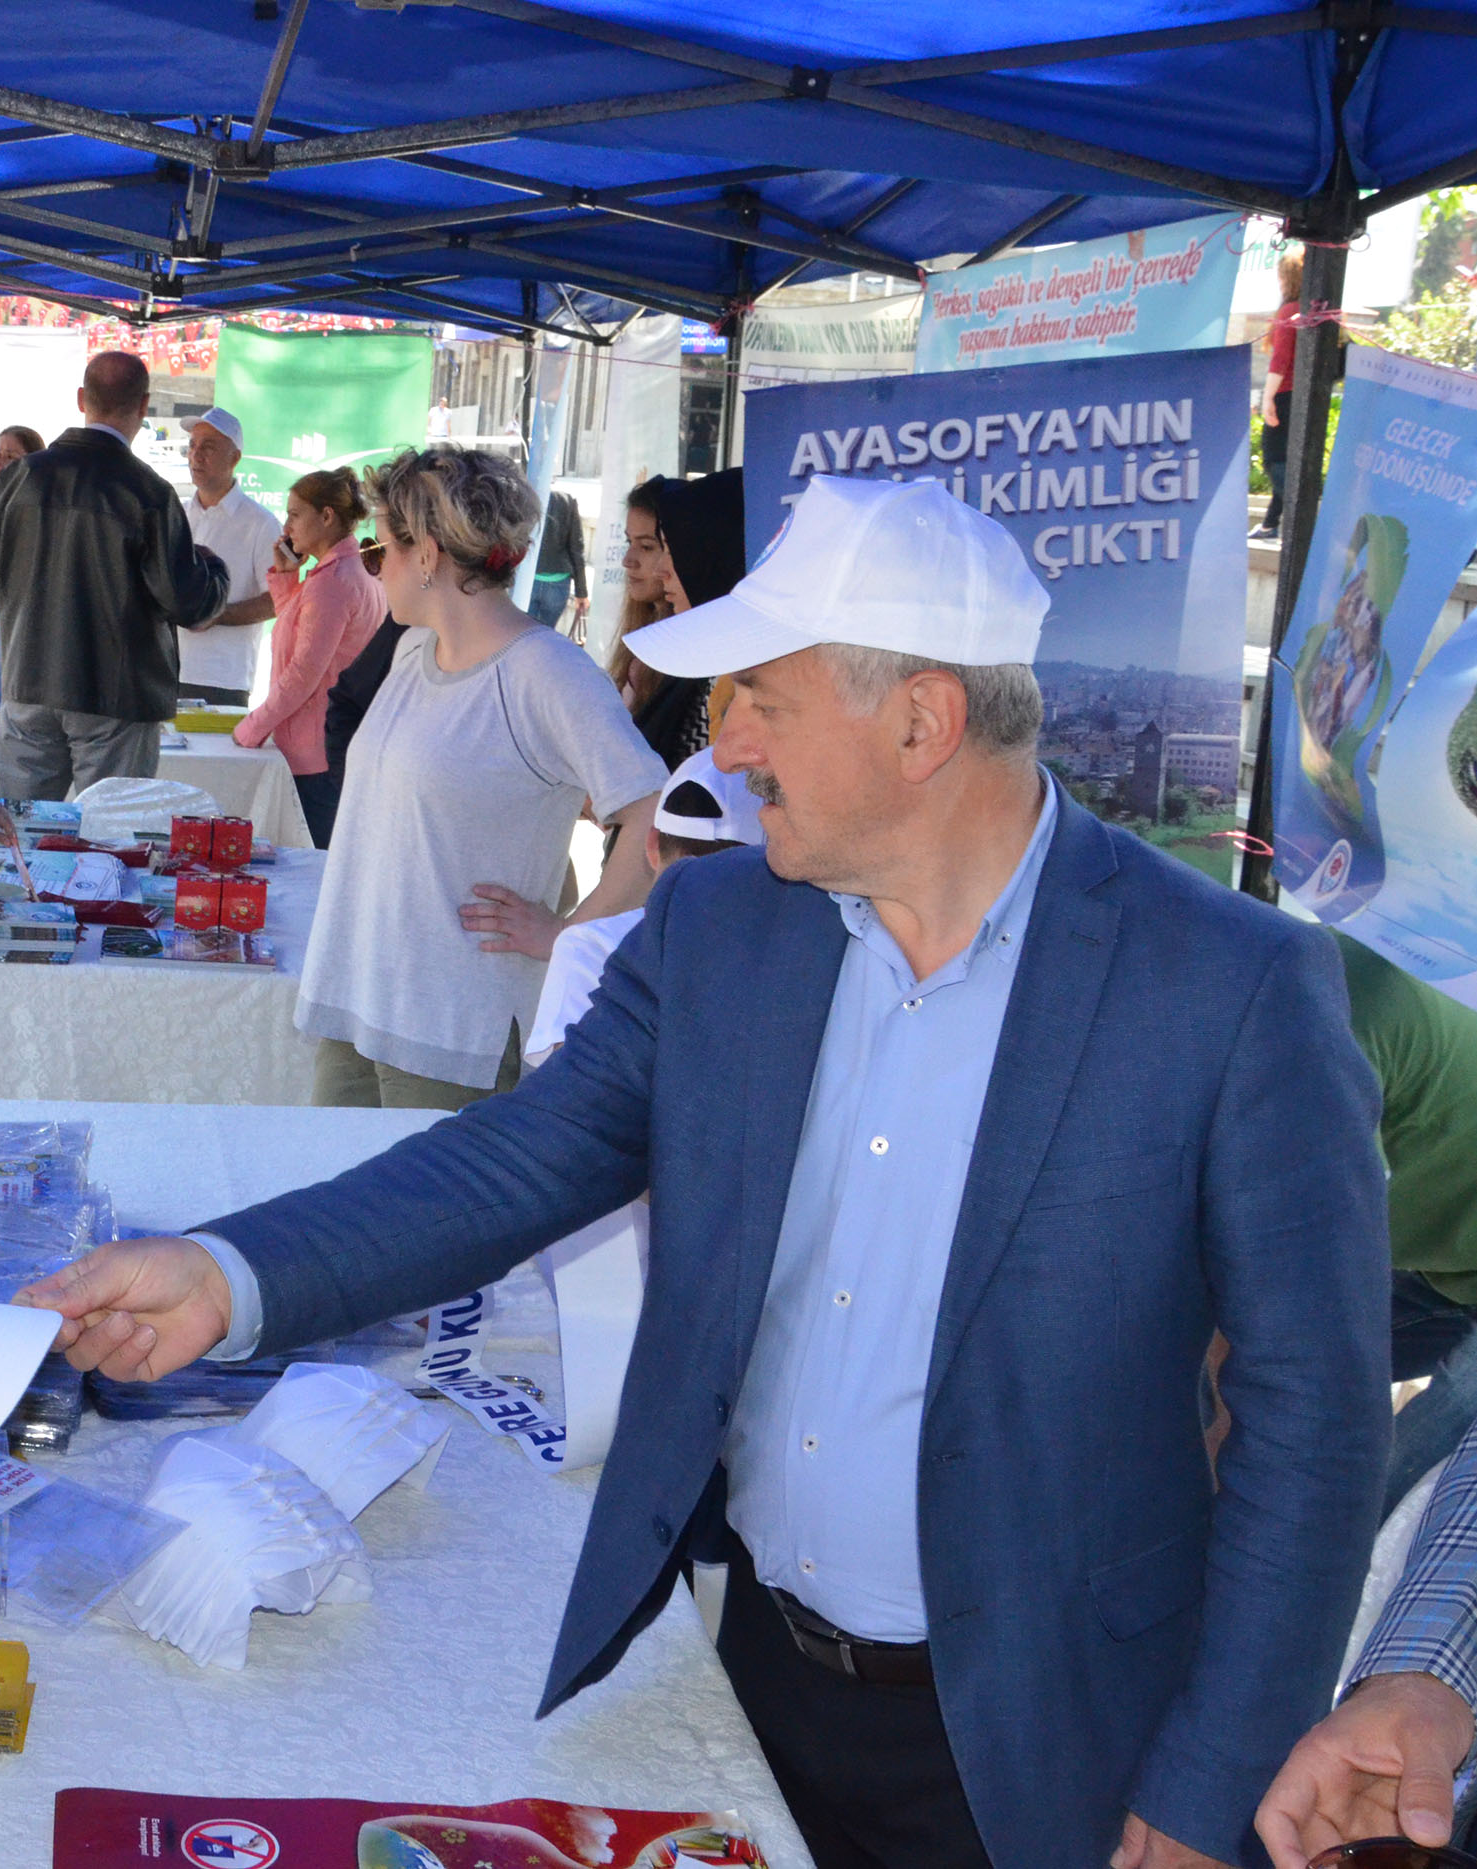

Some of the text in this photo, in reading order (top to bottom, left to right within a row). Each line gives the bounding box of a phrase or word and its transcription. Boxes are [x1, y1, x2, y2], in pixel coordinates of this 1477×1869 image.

[1027, 282, 1042, 304] ve
[1046, 264, 1103, 306] dengeli
[1106, 255, 1132, 288] bir
[1132, 238, 1204, 295] çevrede
[957, 325, 1008, 362] yaşama
[789, 398, 1194, 478] AYASOFYA'NIN
[1385, 418, 1462, 460] GELECEK
[236, 473, 262, 488] T.C.
[980, 448, 1201, 515] KİMLİĞİ
[1033, 518, 1181, 580] ÇIKTI
[420, 1348, 508, 1400] GÜNÜ
[482, 1401, 566, 1462] ÇERE
